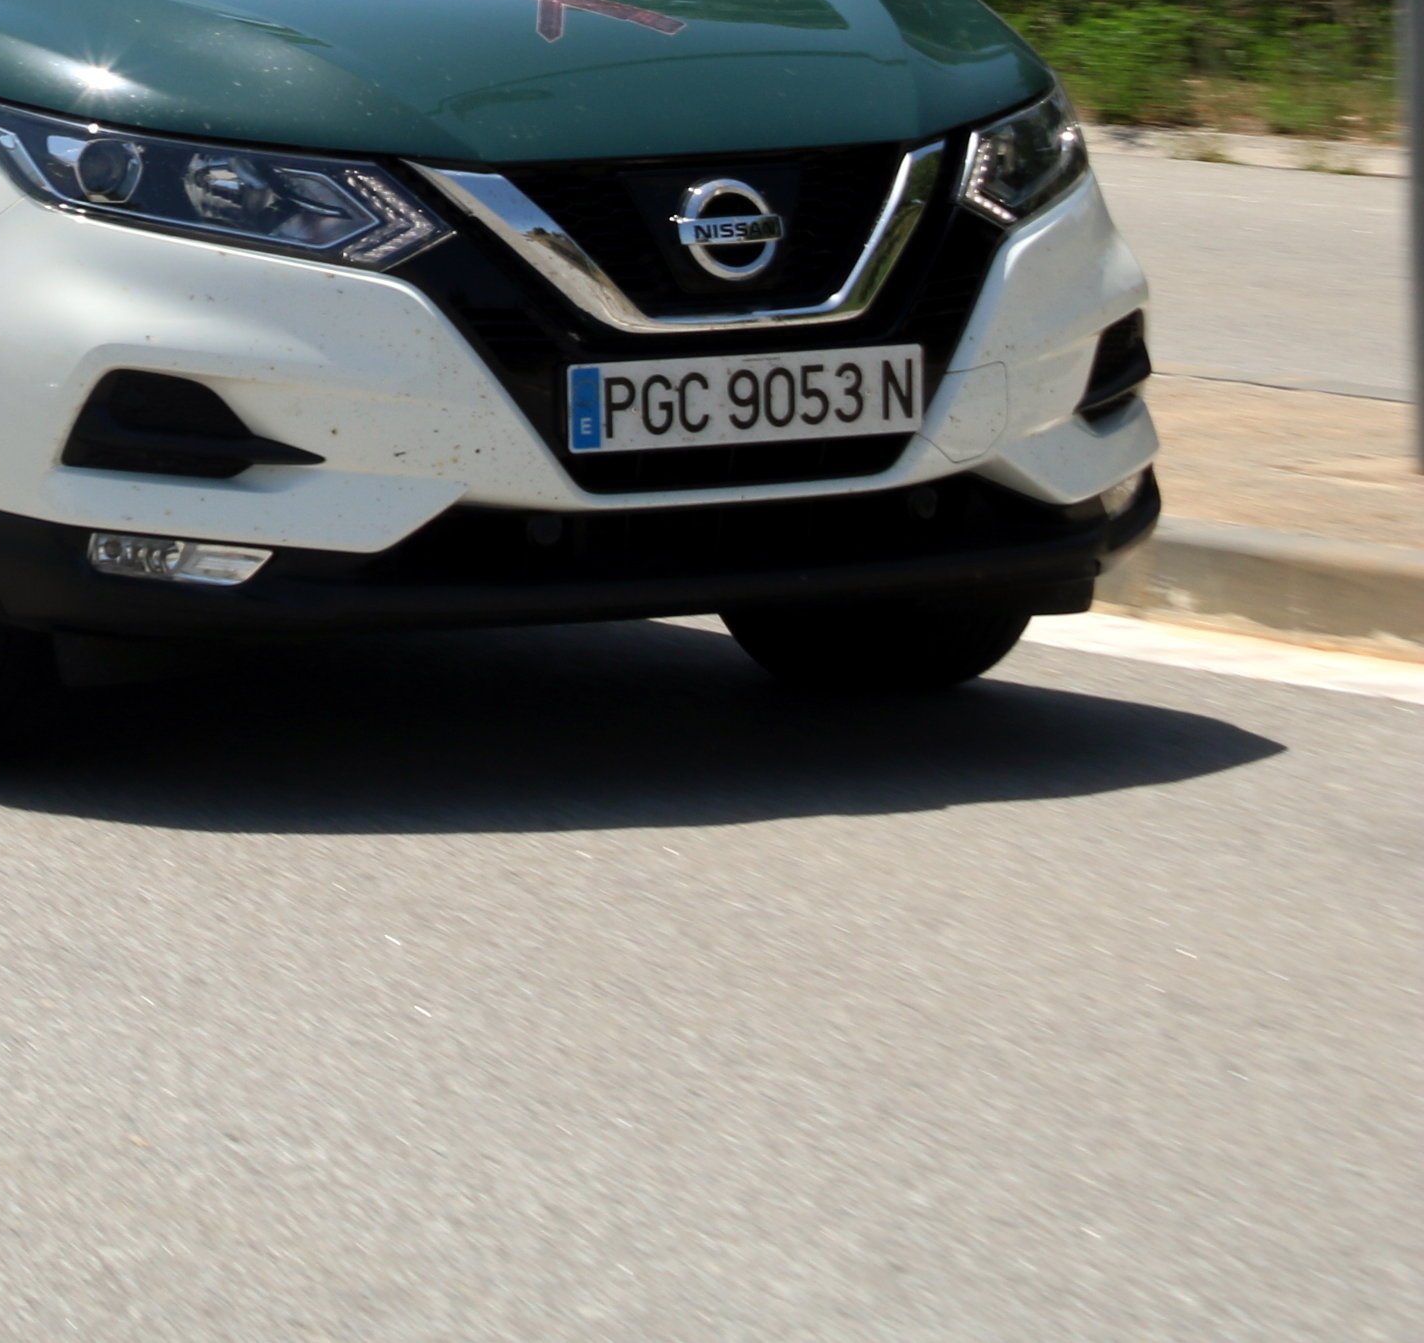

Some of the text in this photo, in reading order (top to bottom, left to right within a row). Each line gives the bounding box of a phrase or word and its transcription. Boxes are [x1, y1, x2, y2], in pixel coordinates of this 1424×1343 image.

[694, 221, 777, 239] NISSAN
[604, 358, 914, 439] PGC 9053 N
